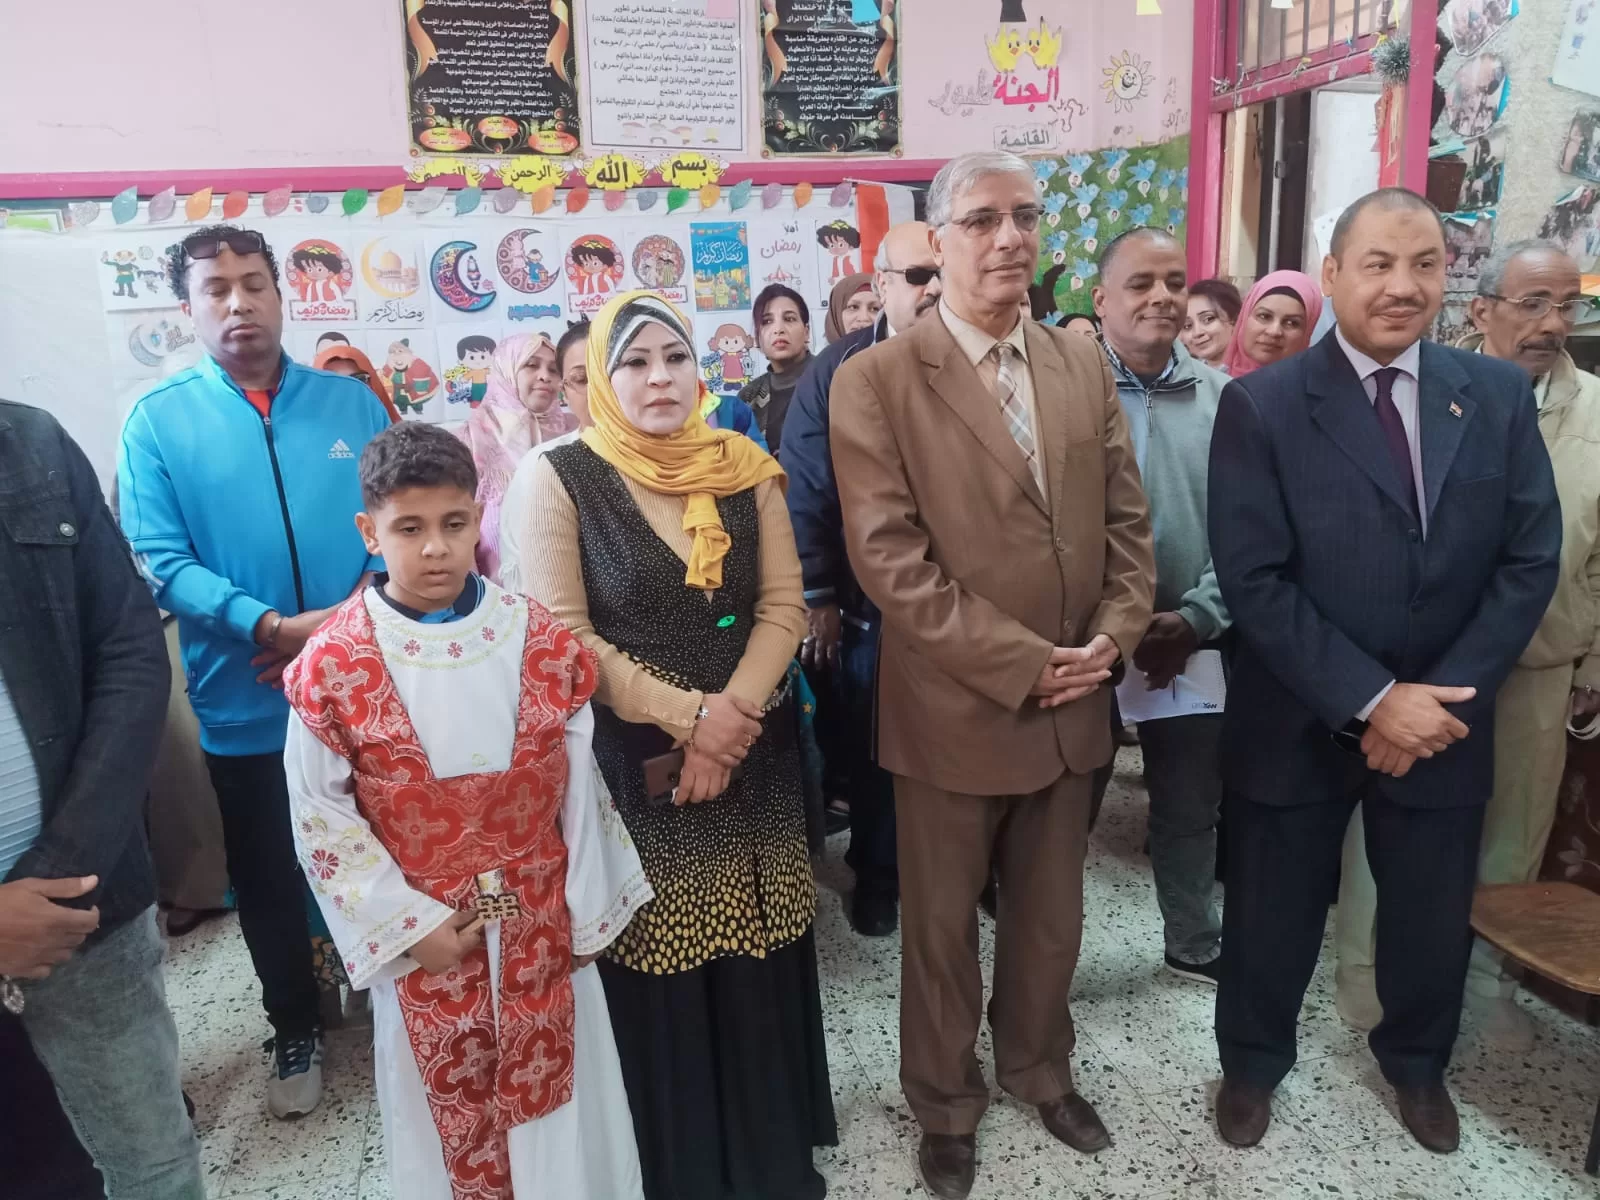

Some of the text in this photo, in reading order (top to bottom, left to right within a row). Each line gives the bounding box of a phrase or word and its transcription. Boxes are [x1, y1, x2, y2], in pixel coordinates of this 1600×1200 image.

[992, 66, 1060, 113] الجنة
[510, 164, 551, 182] الرحمن
[596, 154, 629, 184] الله
[672, 158, 708, 178] بسم
[760, 239, 802, 259] رمضان
